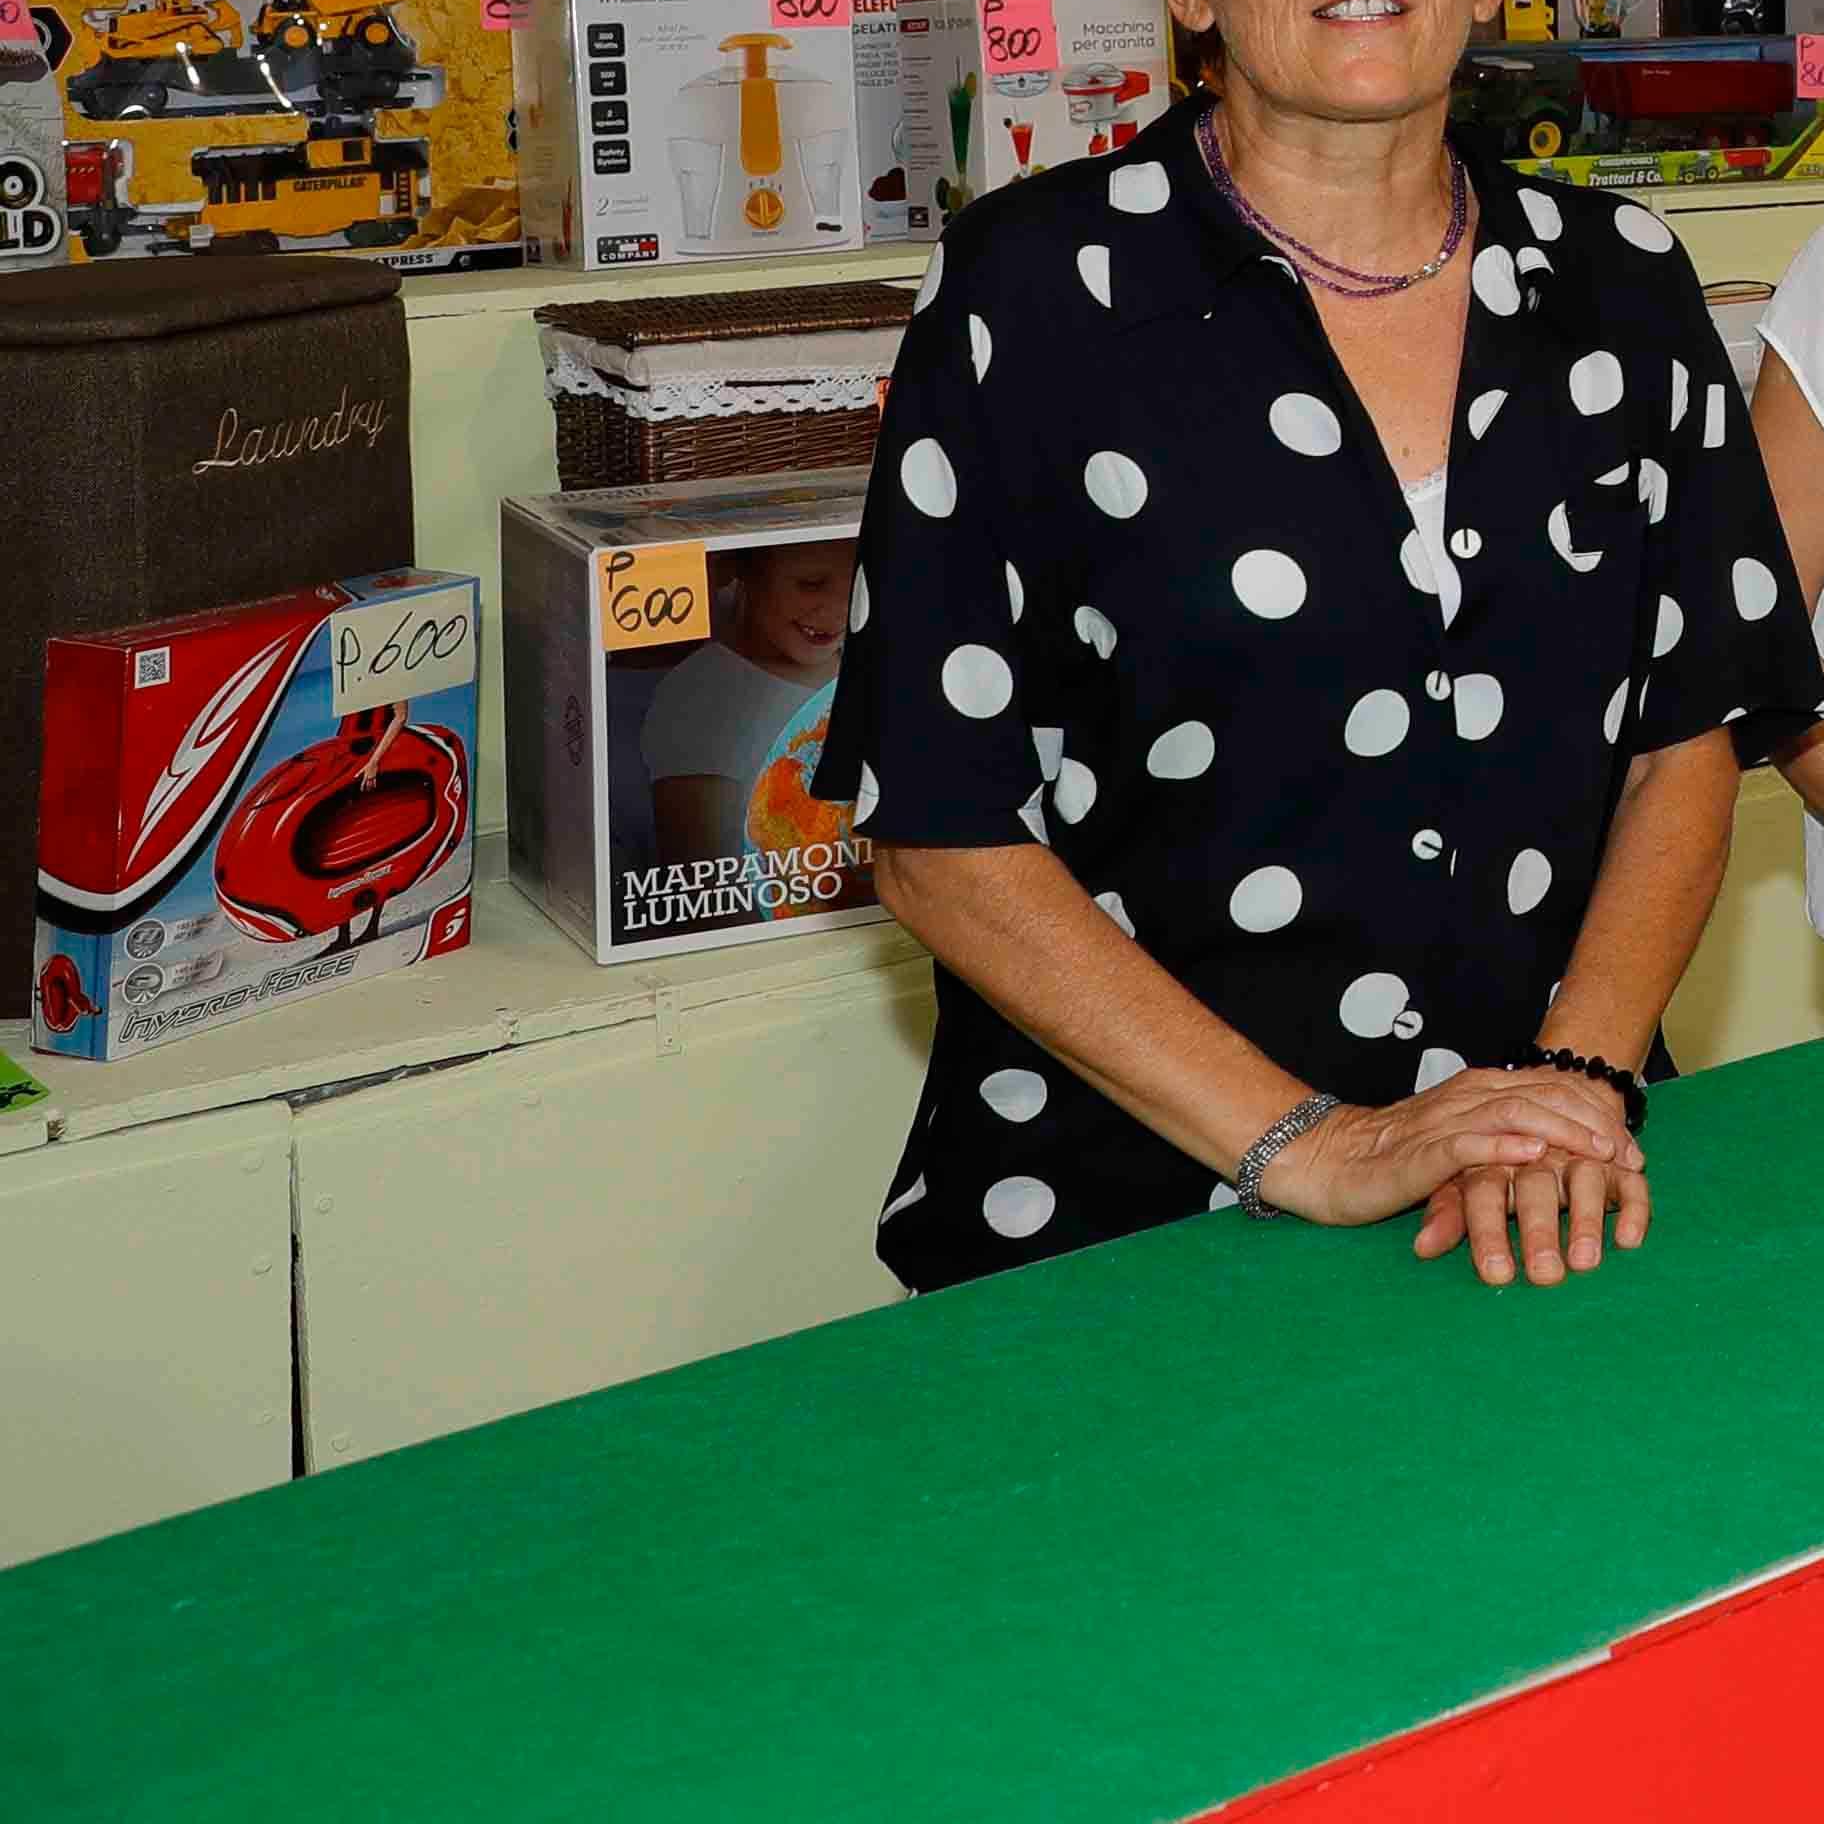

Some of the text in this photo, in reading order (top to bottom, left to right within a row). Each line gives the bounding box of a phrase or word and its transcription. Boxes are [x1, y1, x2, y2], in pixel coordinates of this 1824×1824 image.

[1083, 22, 1155, 37] Macchina
[986, 27, 1041, 61] 800
[1073, 35, 1156, 54] per granita
[1801, 37, 1816, 57] P
[1588, 170, 1632, 186] Trattori
[600, 249, 657, 262] COMPANY
[192, 383, 385, 475] Laundry
[606, 551, 635, 593] P
[611, 585, 695, 632] 600
[623, 870, 843, 931] LUMINOSO
